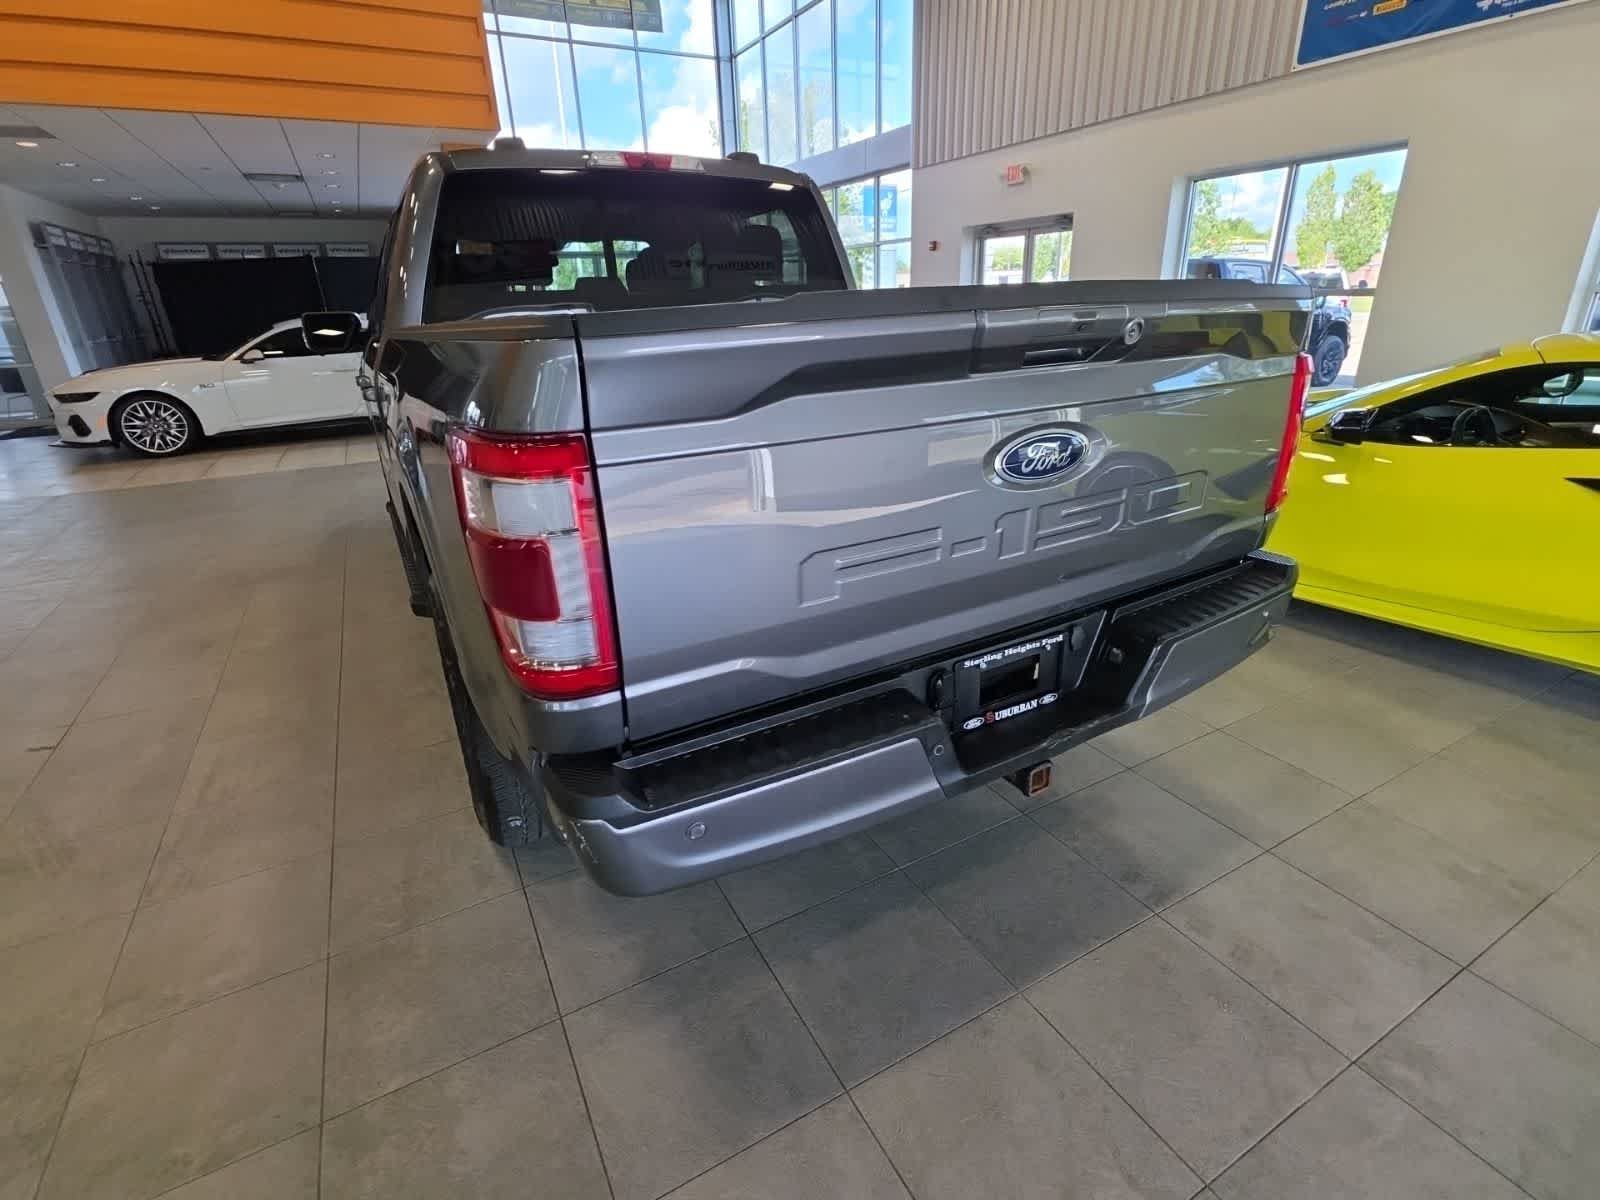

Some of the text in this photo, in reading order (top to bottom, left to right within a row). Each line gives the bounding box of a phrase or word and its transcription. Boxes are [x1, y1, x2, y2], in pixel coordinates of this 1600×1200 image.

[1020, 440, 1073, 474] Ford
[798, 468, 1209, 607] F-150
[963, 634, 1064, 668] Sterling Heights Ford
[985, 699, 1038, 723] SUBURBAN
